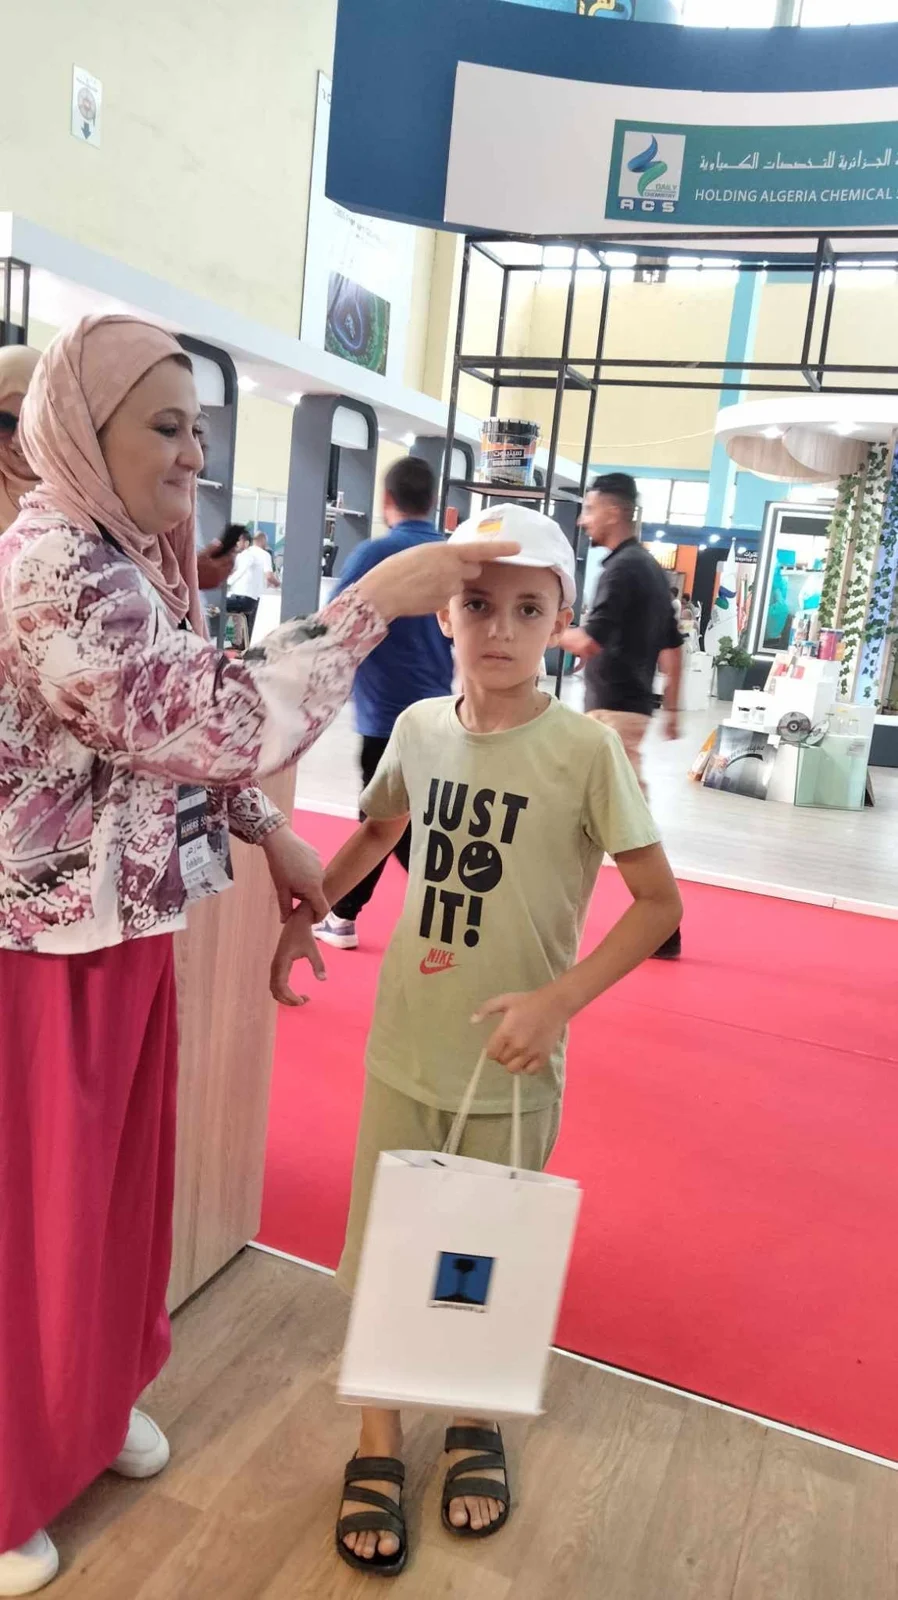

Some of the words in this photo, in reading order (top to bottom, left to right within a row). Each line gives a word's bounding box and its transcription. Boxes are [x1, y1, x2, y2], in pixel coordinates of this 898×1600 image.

[695, 189, 757, 202] HOLDING
[759, 189, 817, 202] ALGERIA
[820, 187, 892, 202] CHEMICAL
[423, 778, 529, 844] JUST
[424, 829, 503, 893] DO
[419, 885, 484, 948] IT!
[426, 947, 456, 966] NIKE
